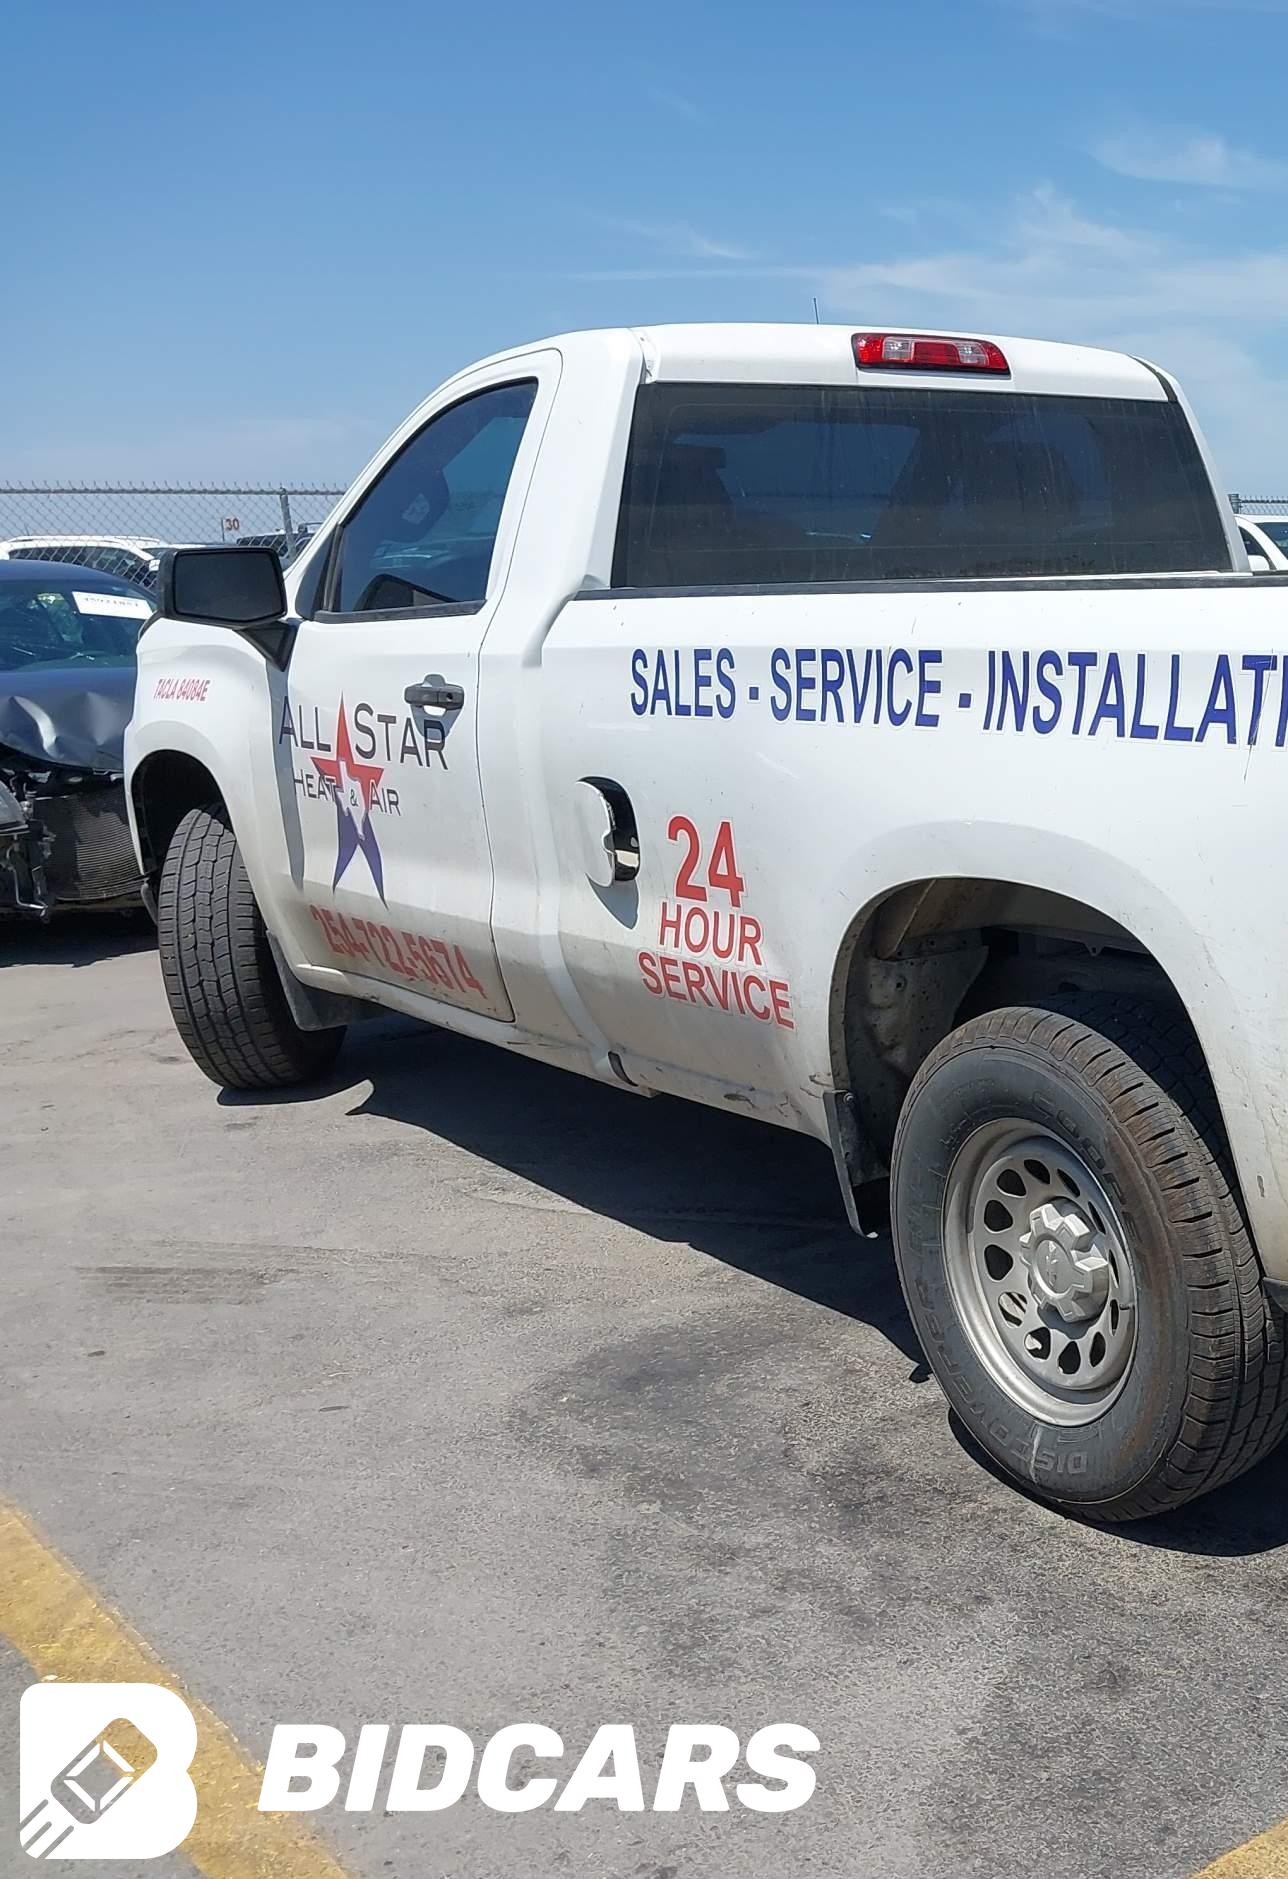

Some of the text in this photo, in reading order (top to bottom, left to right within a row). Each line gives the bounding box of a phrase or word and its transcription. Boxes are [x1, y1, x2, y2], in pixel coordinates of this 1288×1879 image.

[225, 518, 241, 531] 30
[631, 648, 736, 719] SALES
[769, 648, 943, 727] SERVICE
[279, 695, 448, 770] ALL STAR
[294, 769, 401, 816] HEAT & AIR
[668, 815, 744, 908] 24
[310, 904, 489, 999] 254-722-5674
[659, 901, 762, 966] HOUR
[638, 951, 795, 1029] SERVICE
